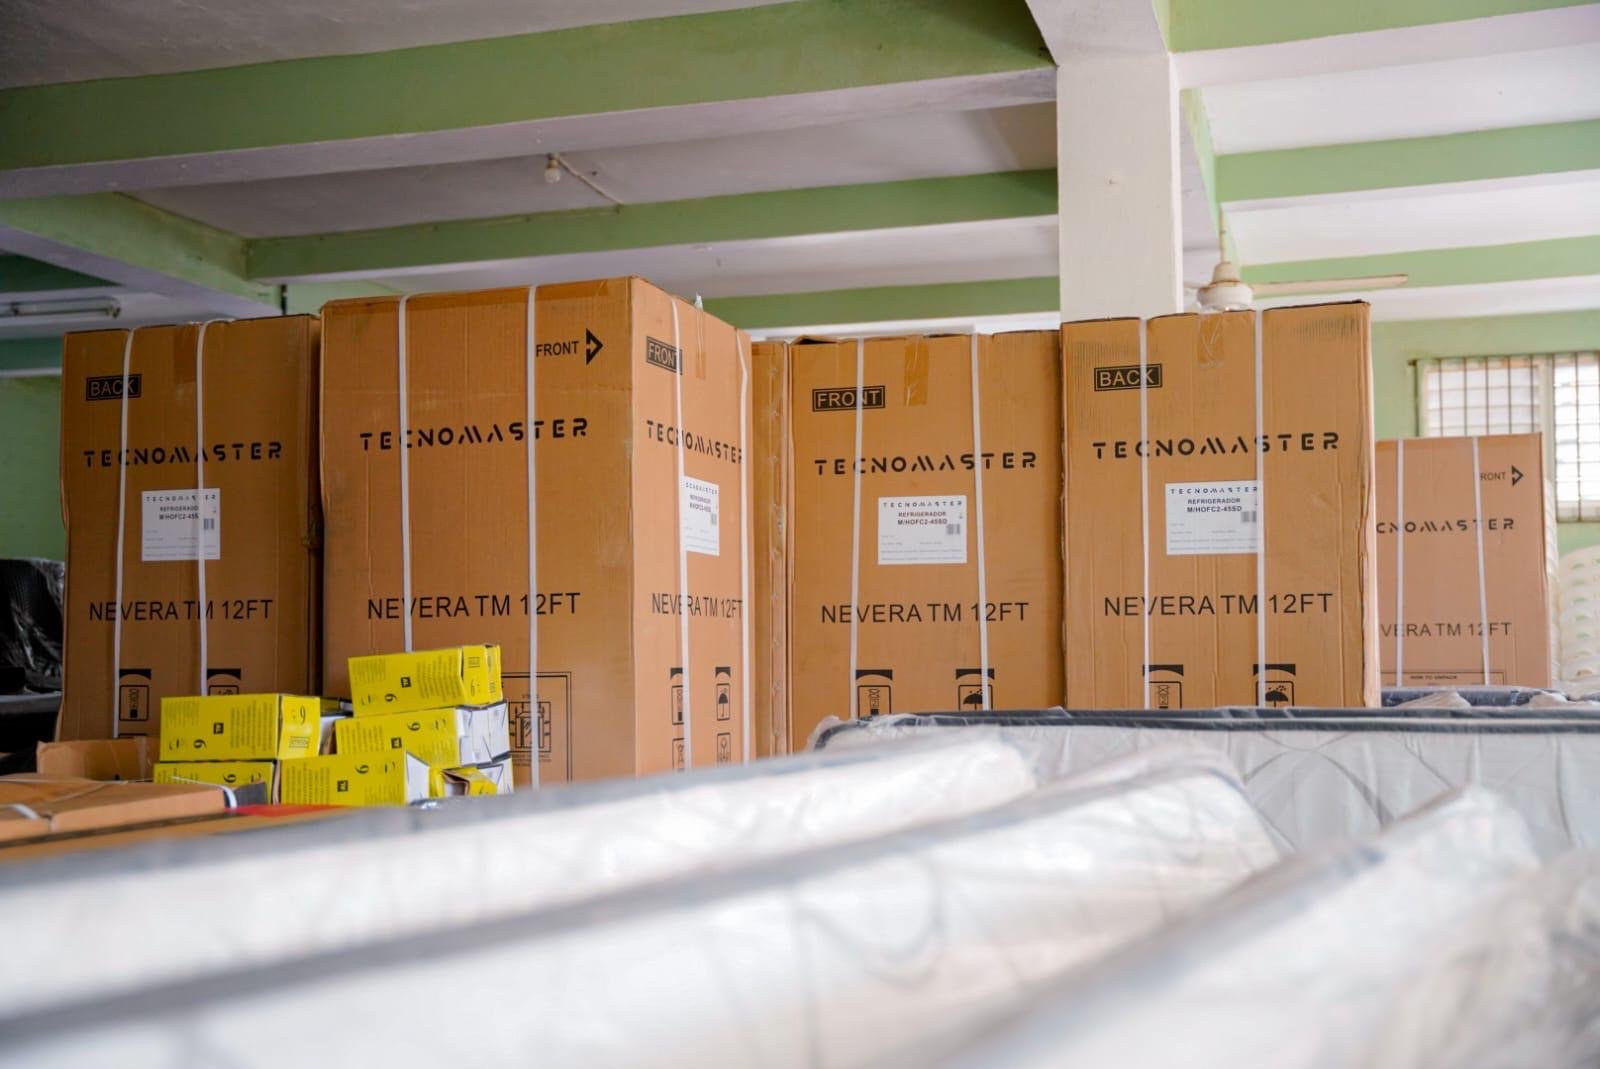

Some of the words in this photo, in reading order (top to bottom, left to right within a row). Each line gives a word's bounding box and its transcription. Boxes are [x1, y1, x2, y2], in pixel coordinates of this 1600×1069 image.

[536, 340, 580, 357] FRONT
[90, 379, 135, 397] BACK
[1099, 369, 1155, 387] BACK
[360, 417, 588, 451] TECNOMASTER
[83, 441, 283, 468] TECNOMASTER
[1092, 431, 1340, 460] TECNOMASTER
[814, 451, 1037, 476] TECNOMASTER
[1479, 471, 1506, 481] RONT
[1376, 518, 1514, 534] CNOMASER
[89, 601, 179, 621] NEVERA
[183, 600, 214, 620] TM
[221, 599, 273, 619] 12FT
[367, 596, 470, 620] NEVERA
[474, 594, 511, 617] TM
[519, 592, 581, 615] 12FT
[703, 596, 718, 617] TM
[820, 605, 922, 624] NEVERA
[927, 603, 962, 622] TM
[970, 602, 1030, 621] 12FT
[1104, 596, 1216, 617] NEVERA
[1219, 594, 1259, 615] TM
[1268, 593, 1334, 613] 12FT
[1380, 623, 1432, 637] VERA
[1434, 623, 1462, 636] TM
